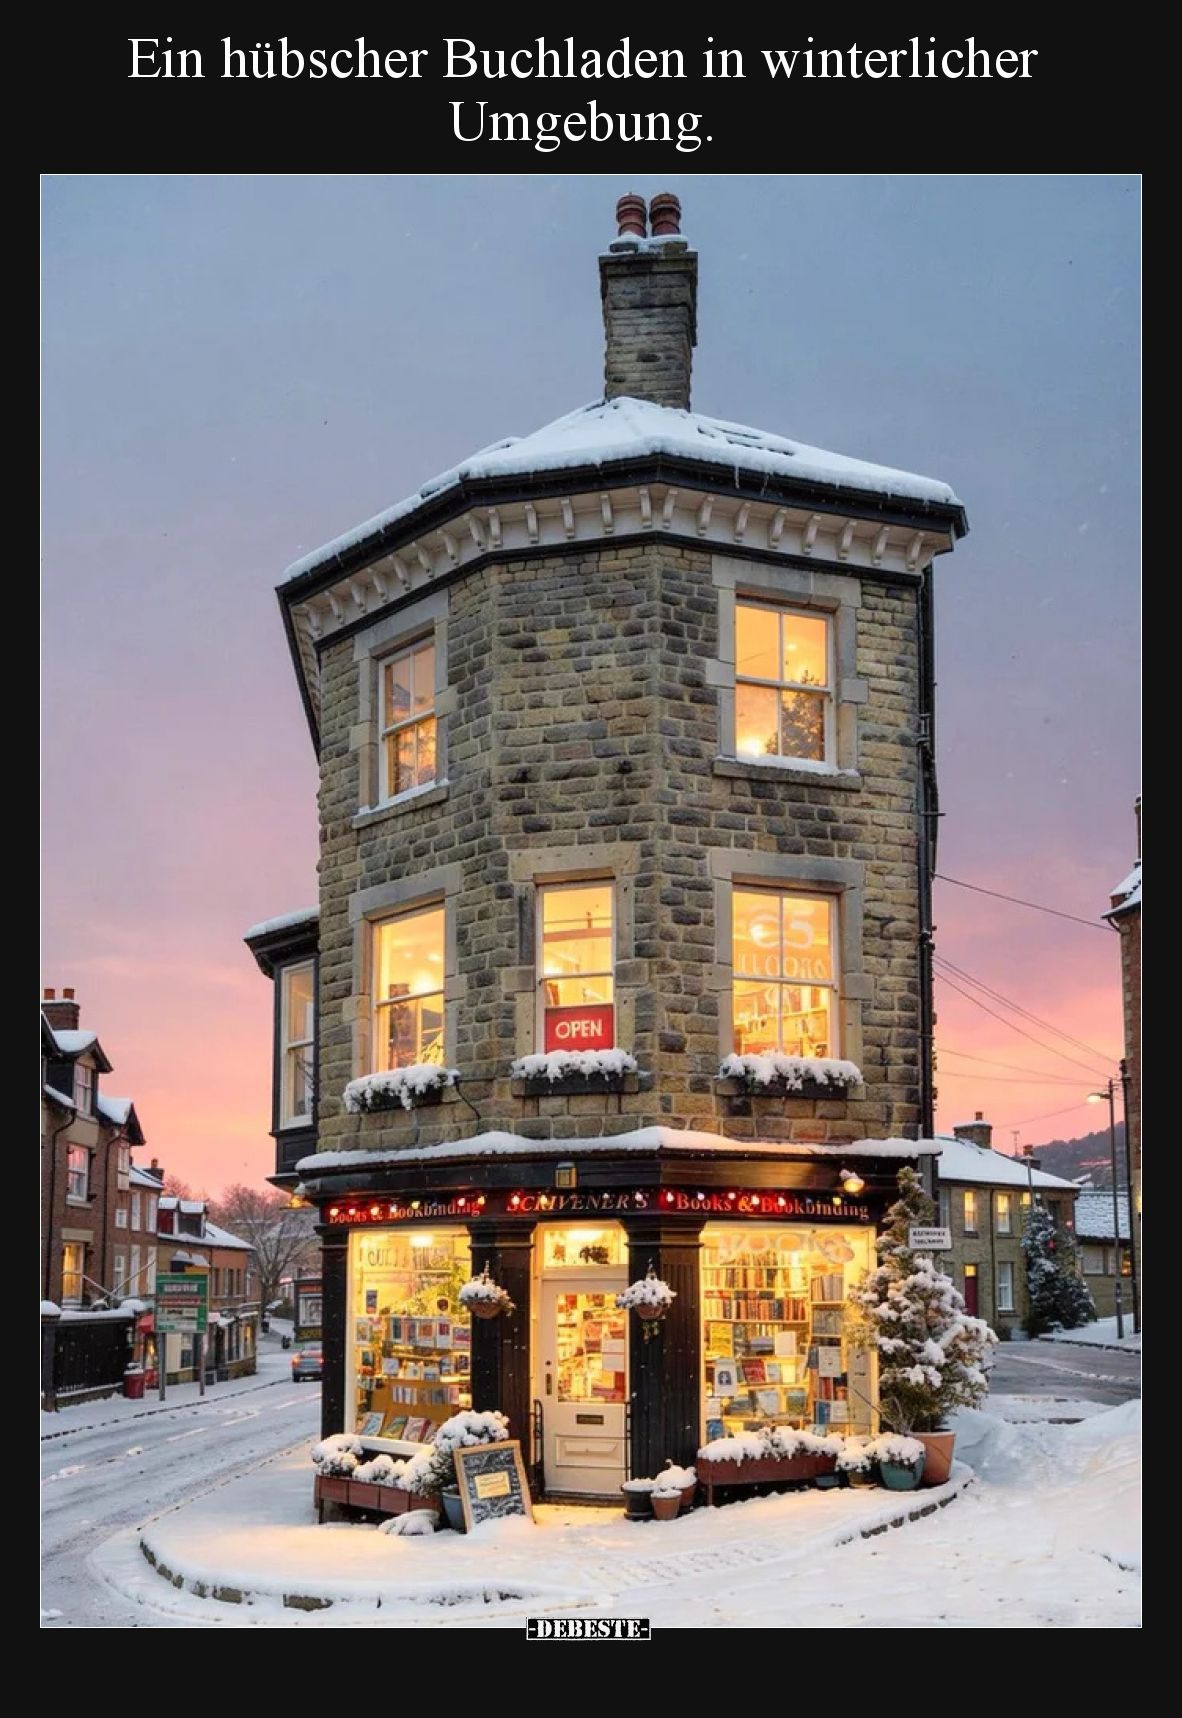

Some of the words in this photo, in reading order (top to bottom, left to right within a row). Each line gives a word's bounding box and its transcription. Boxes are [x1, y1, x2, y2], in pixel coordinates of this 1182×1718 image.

[555, 1018, 603, 1040] OPEN
[676, 1193, 732, 1212] Books
[738, 1196, 754, 1213] &
[761, 1196, 870, 1221] Bookbinding
